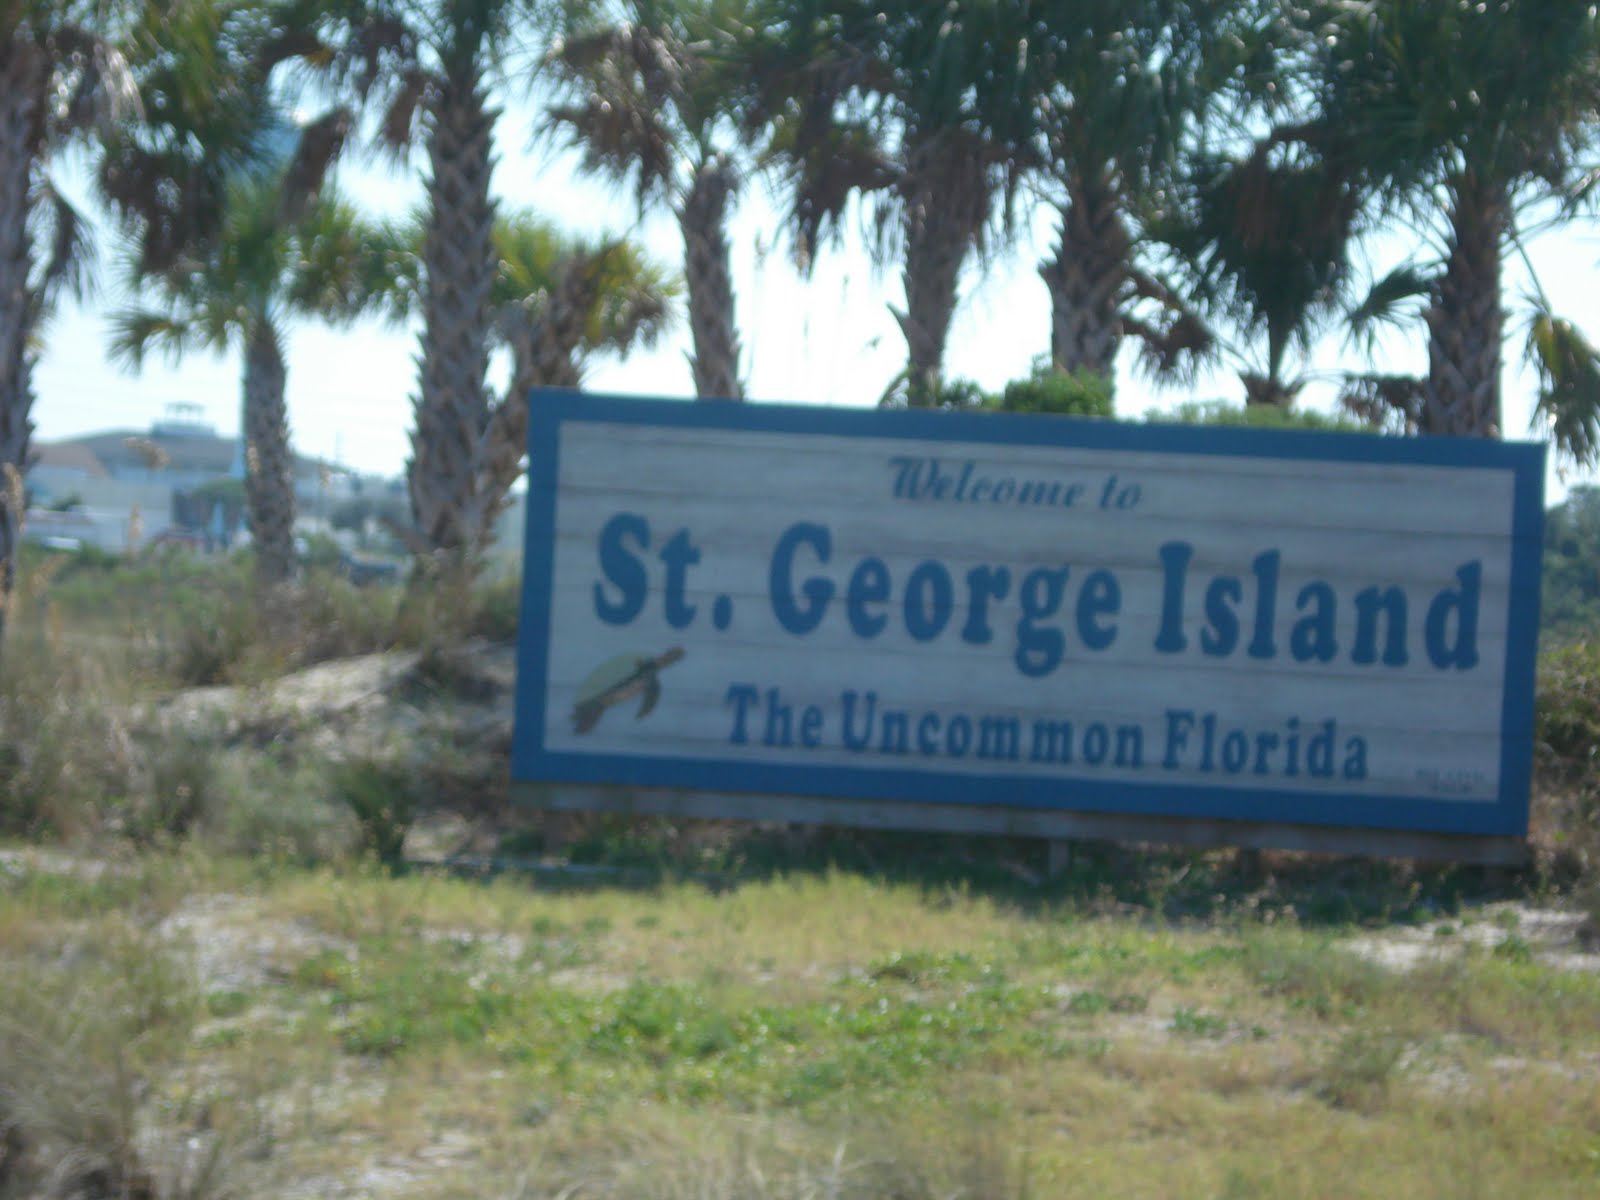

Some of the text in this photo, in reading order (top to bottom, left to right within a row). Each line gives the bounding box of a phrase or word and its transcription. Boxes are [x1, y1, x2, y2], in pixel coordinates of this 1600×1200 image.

[889, 456, 1143, 511] Welcome to
[593, 512, 1484, 678] St. George Island
[726, 683, 1369, 780] The Uncommon Florida
